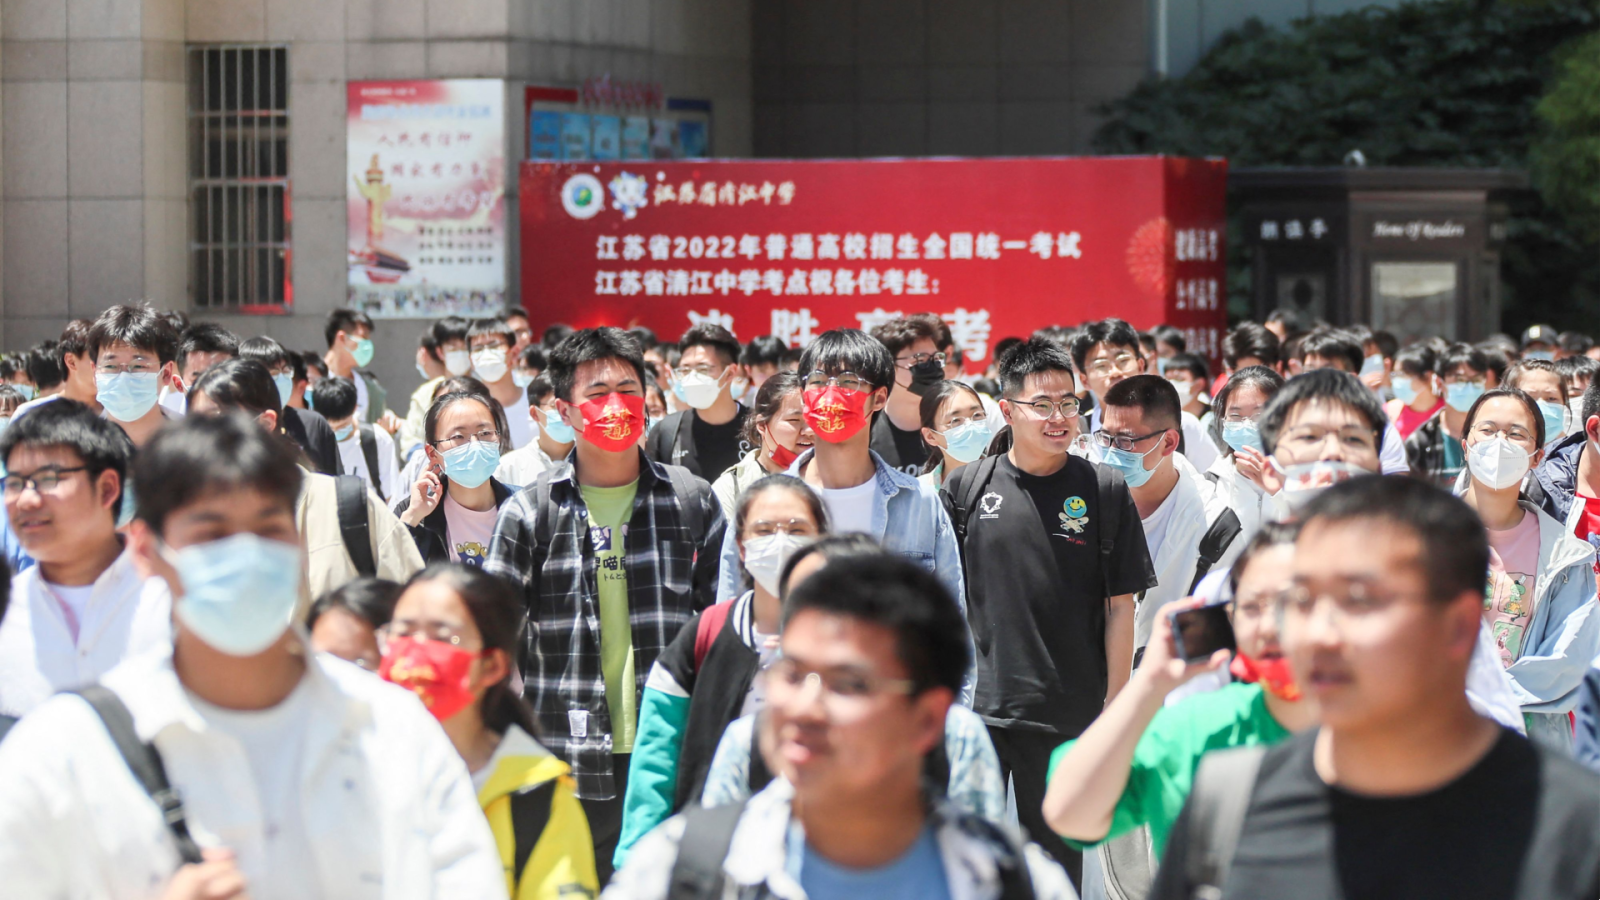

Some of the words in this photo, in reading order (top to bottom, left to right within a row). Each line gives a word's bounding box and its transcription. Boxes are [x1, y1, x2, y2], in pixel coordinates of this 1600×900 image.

[653, 180, 796, 206] 江苏省清江中学
[1372, 220, 1404, 237] Home
[1423, 219, 1465, 239] Readers
[595, 231, 1082, 260] 江苏省2022年普通高校招生全国统一考试
